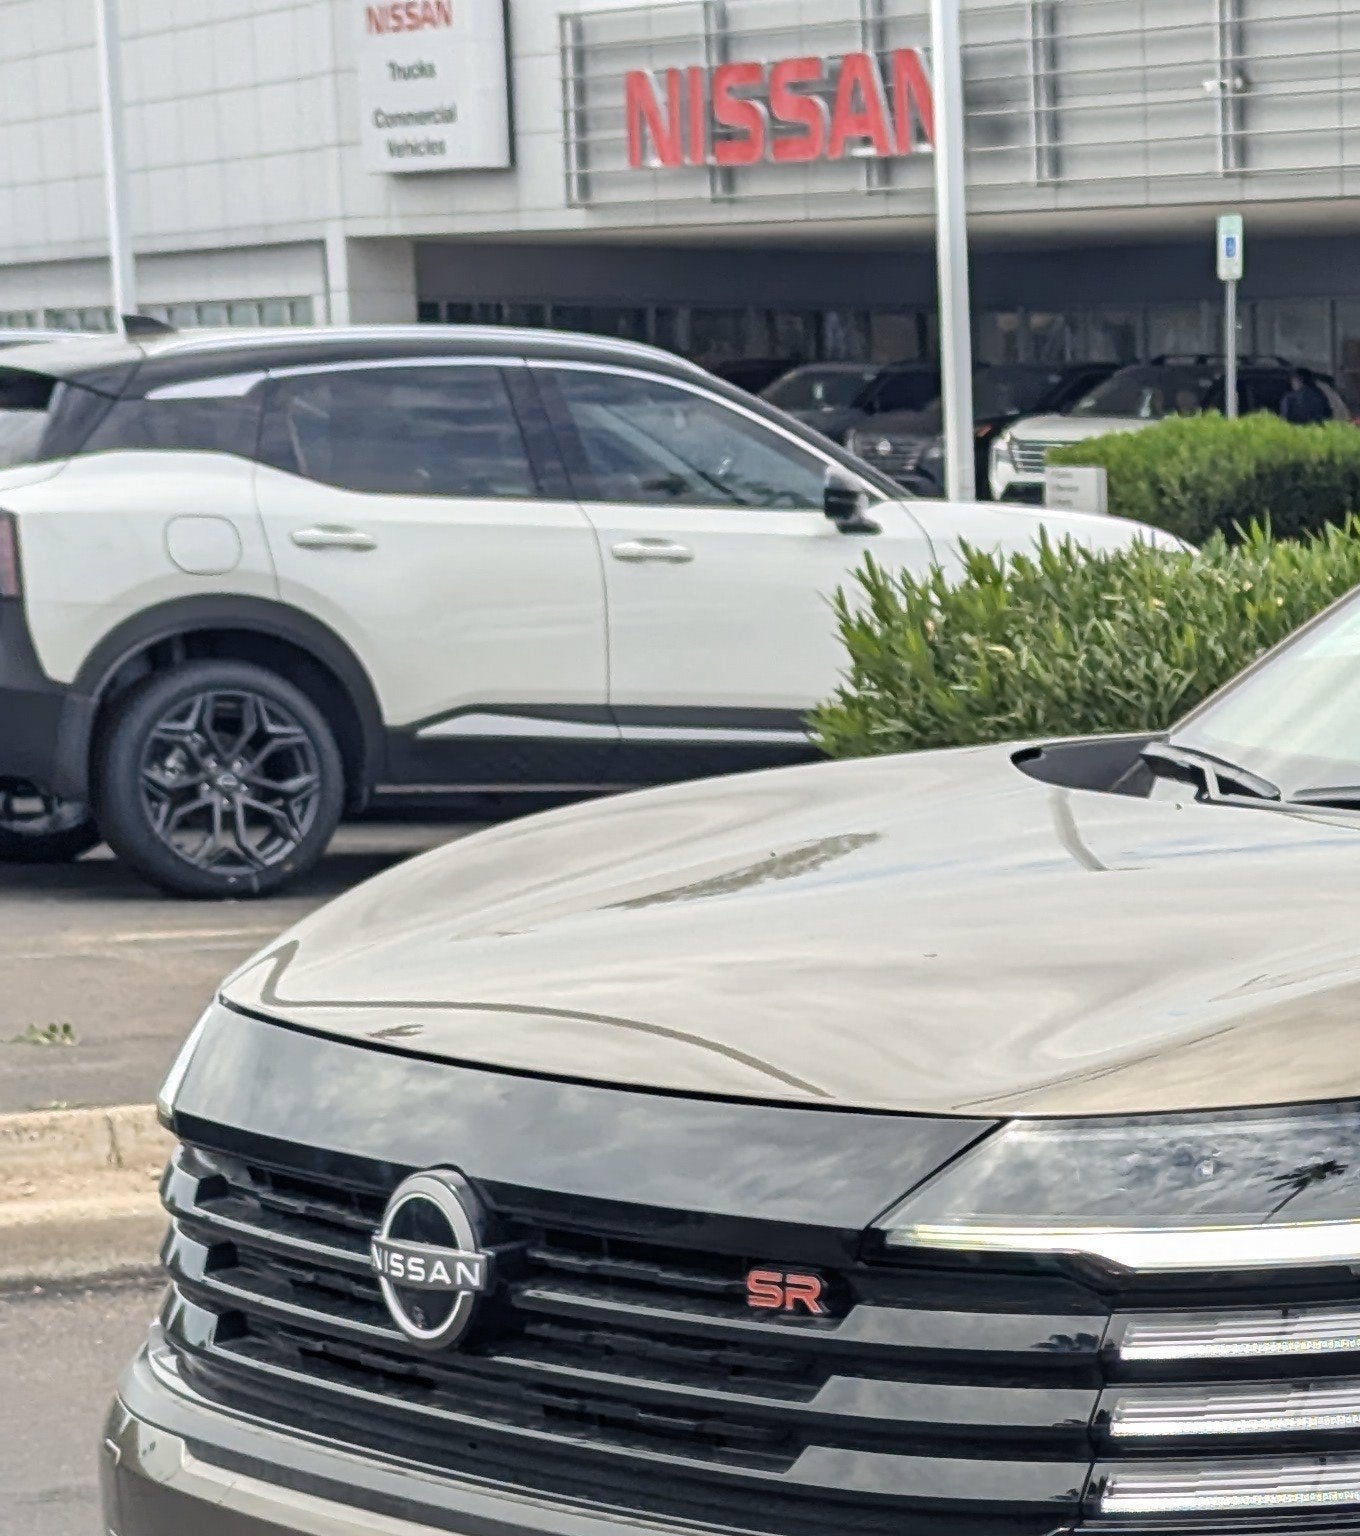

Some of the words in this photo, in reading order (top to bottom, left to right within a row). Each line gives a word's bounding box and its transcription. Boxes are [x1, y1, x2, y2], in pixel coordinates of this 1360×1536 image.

[366, 0, 453, 35] NISSAN
[372, 1244, 481, 1286] NISSAN
[747, 1270, 824, 1314] SR
